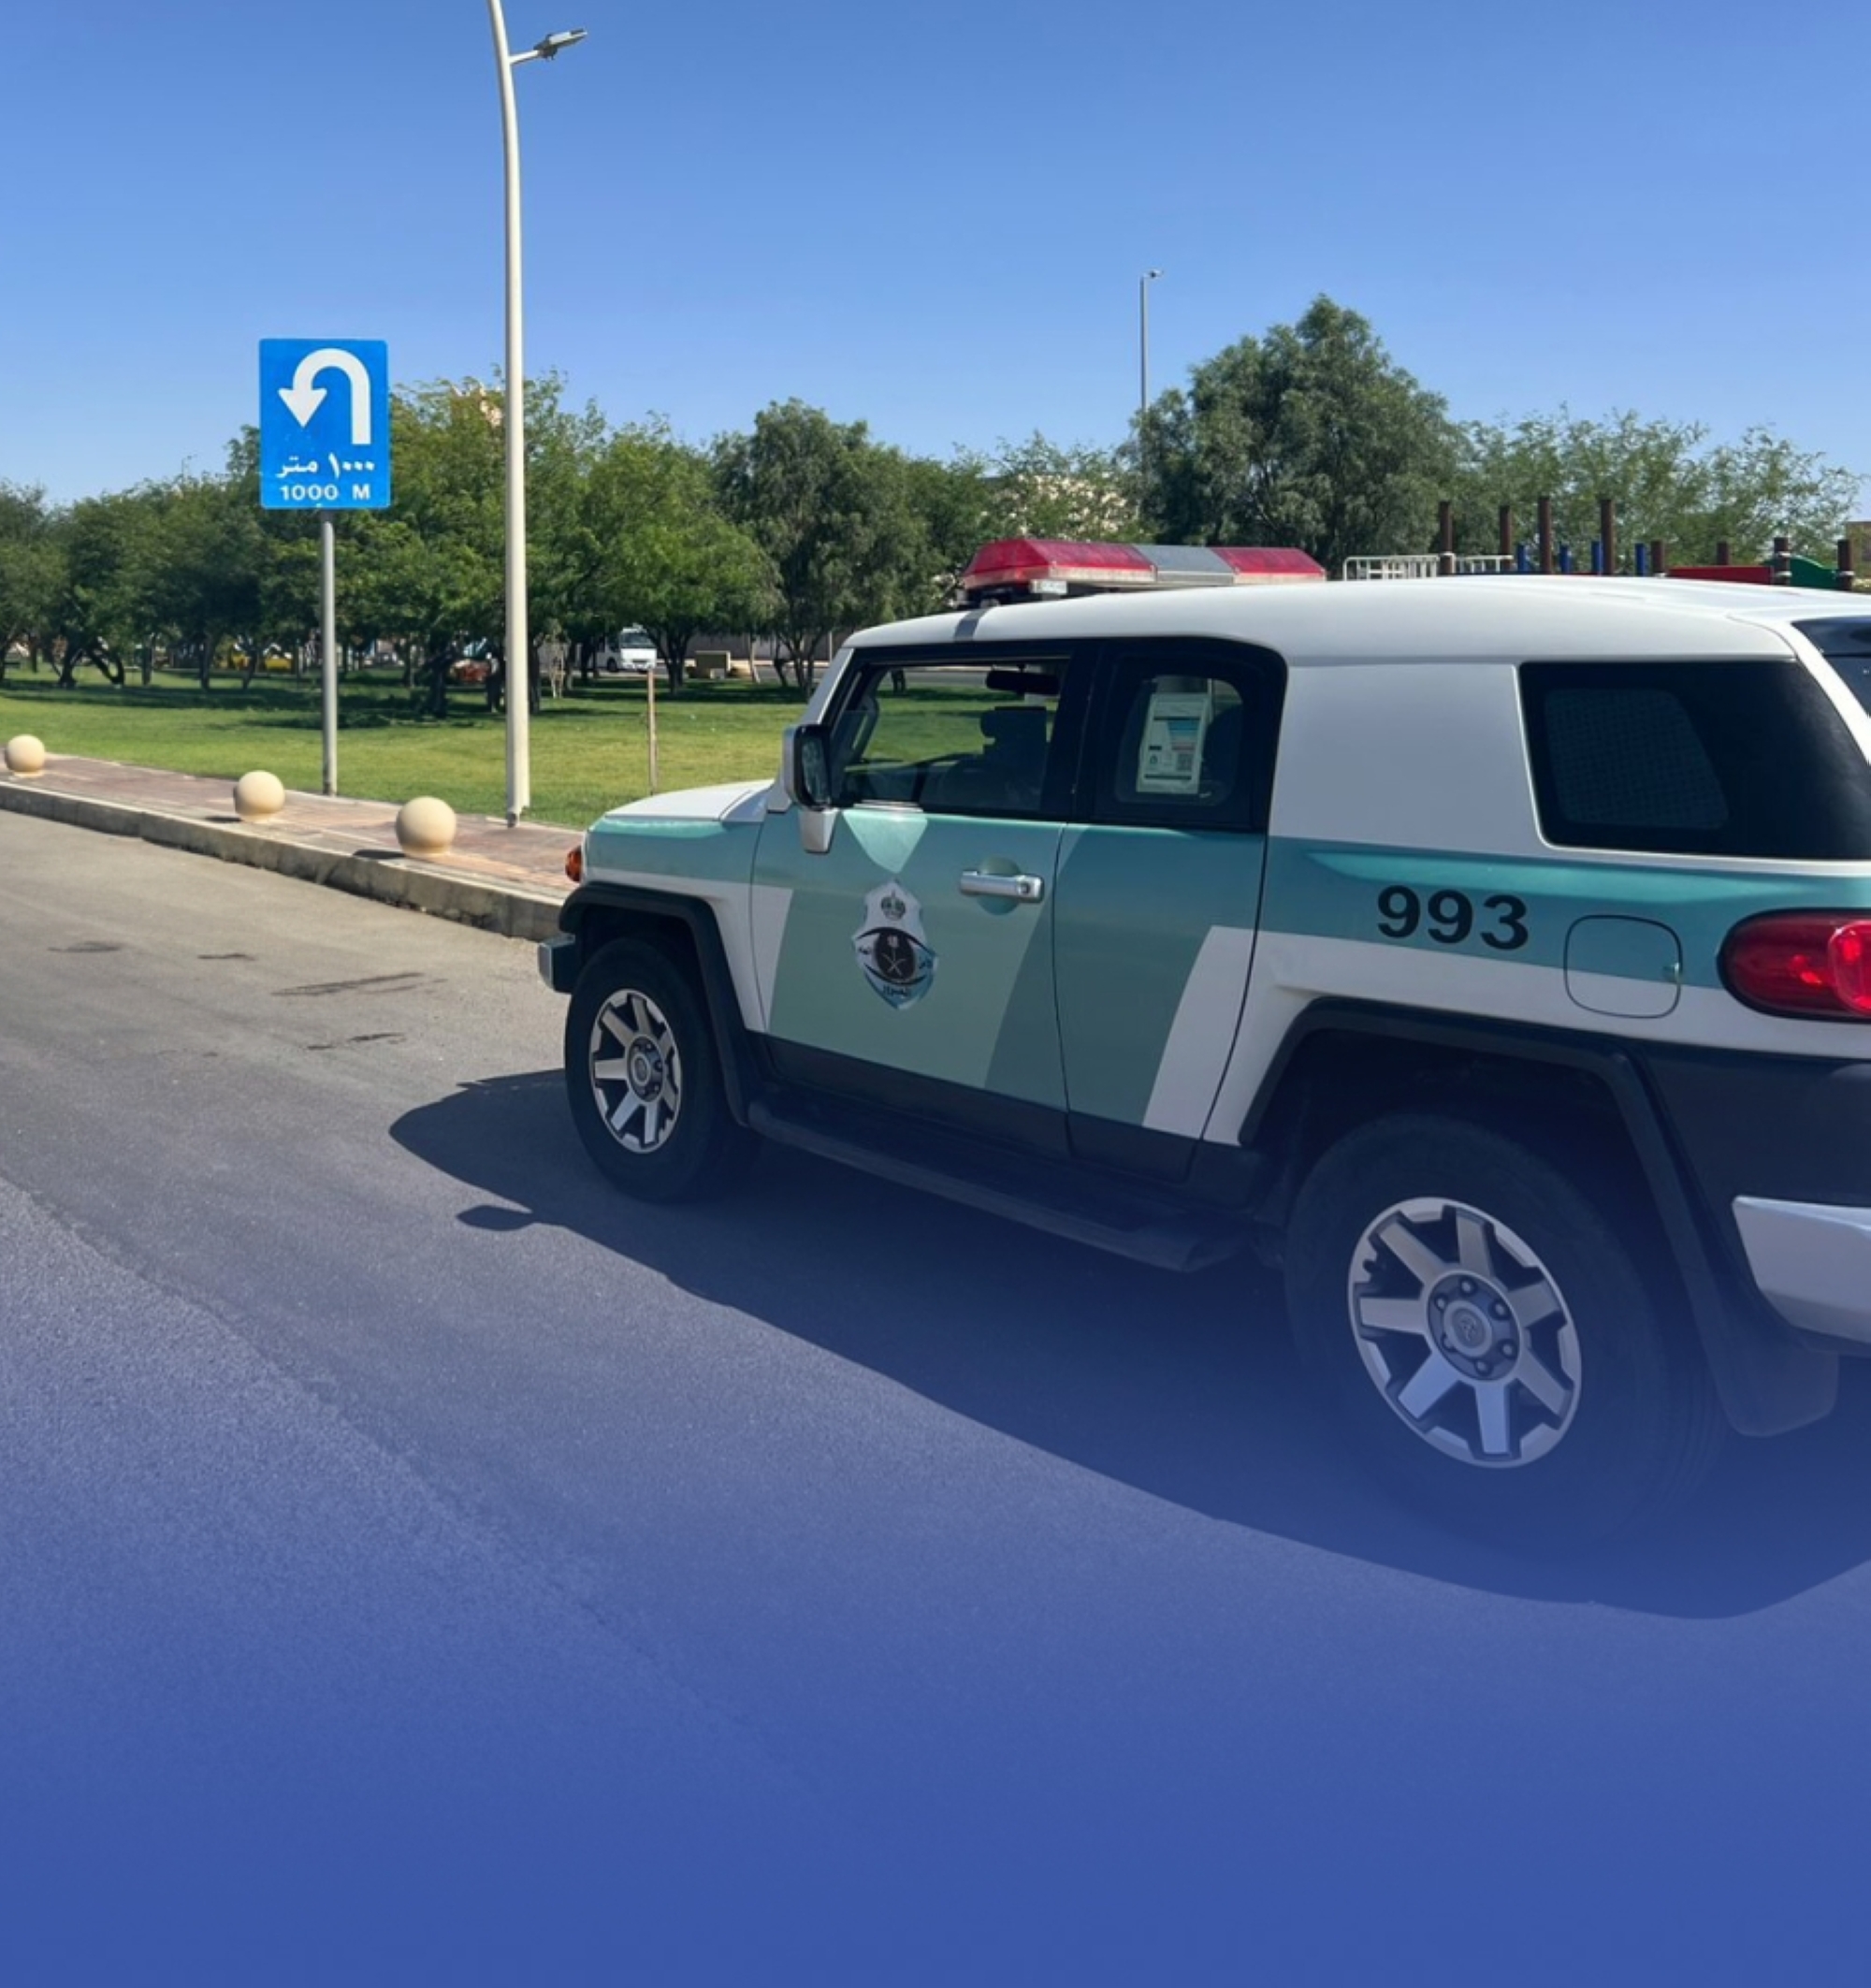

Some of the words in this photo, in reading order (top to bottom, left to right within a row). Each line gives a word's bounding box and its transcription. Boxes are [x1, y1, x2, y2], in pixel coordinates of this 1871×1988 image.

[275, 456, 318, 478] متر
[280, 484, 338, 501] 1000
[352, 484, 370, 501] M
[1377, 884, 1530, 950] 993
